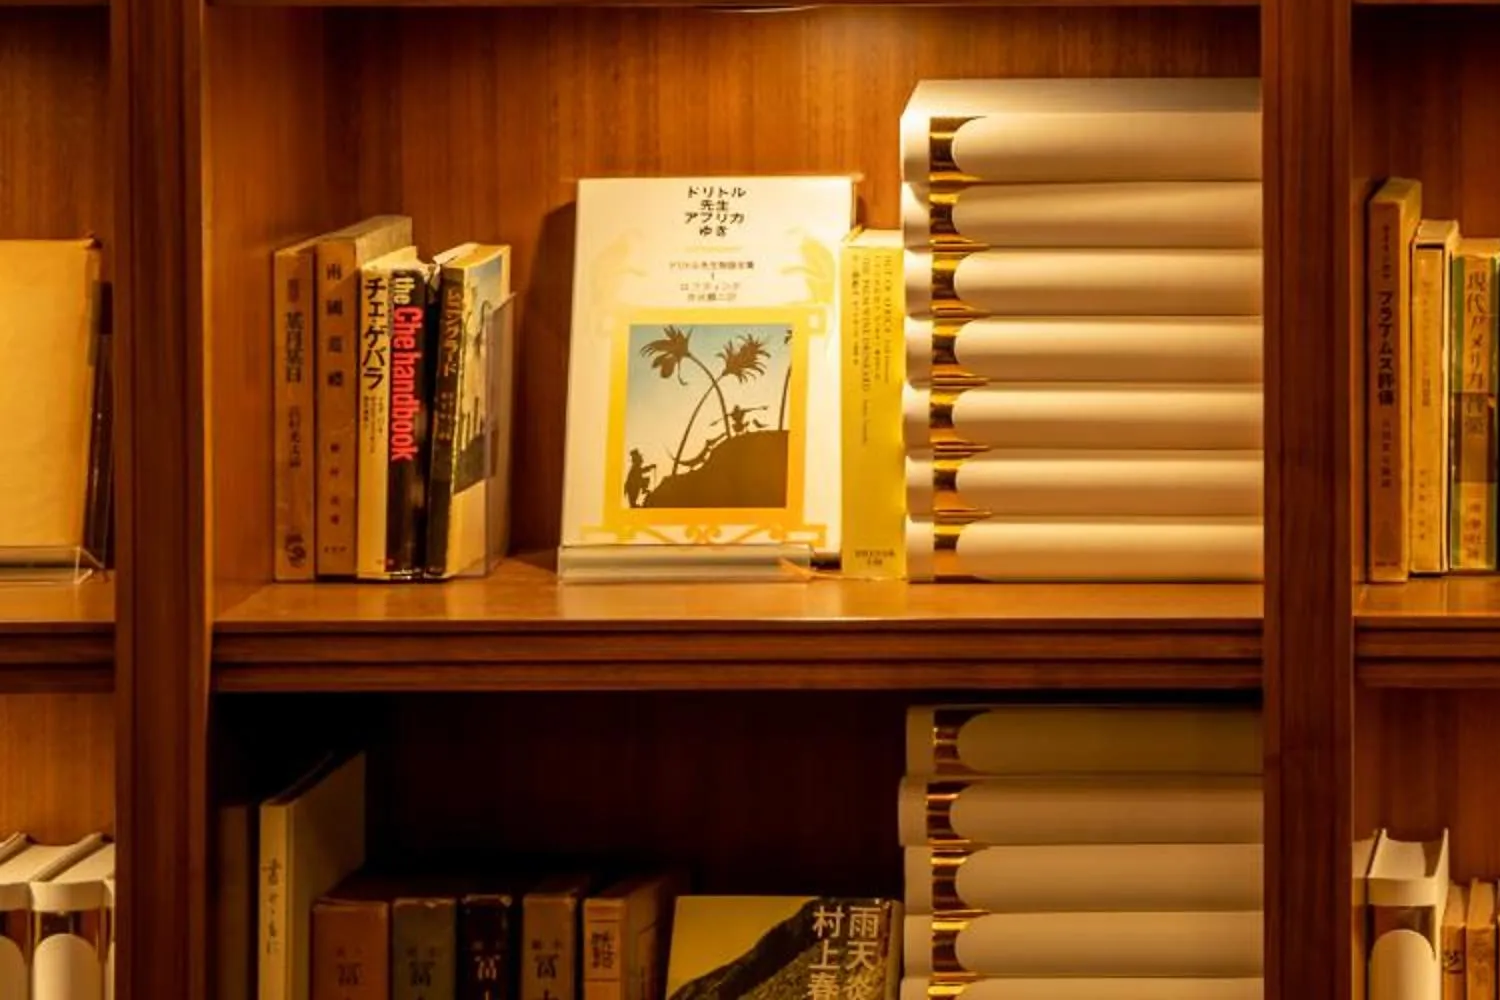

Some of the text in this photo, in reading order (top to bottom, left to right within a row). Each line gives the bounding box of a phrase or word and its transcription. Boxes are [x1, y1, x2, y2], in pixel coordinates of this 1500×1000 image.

[687, 185, 748, 199] ドリトル
[700, 198, 730, 212] 先生
[684, 211, 745, 225] アフリカ
[699, 224, 730, 238] ゆき
[391, 276, 424, 461] the Che handbook
